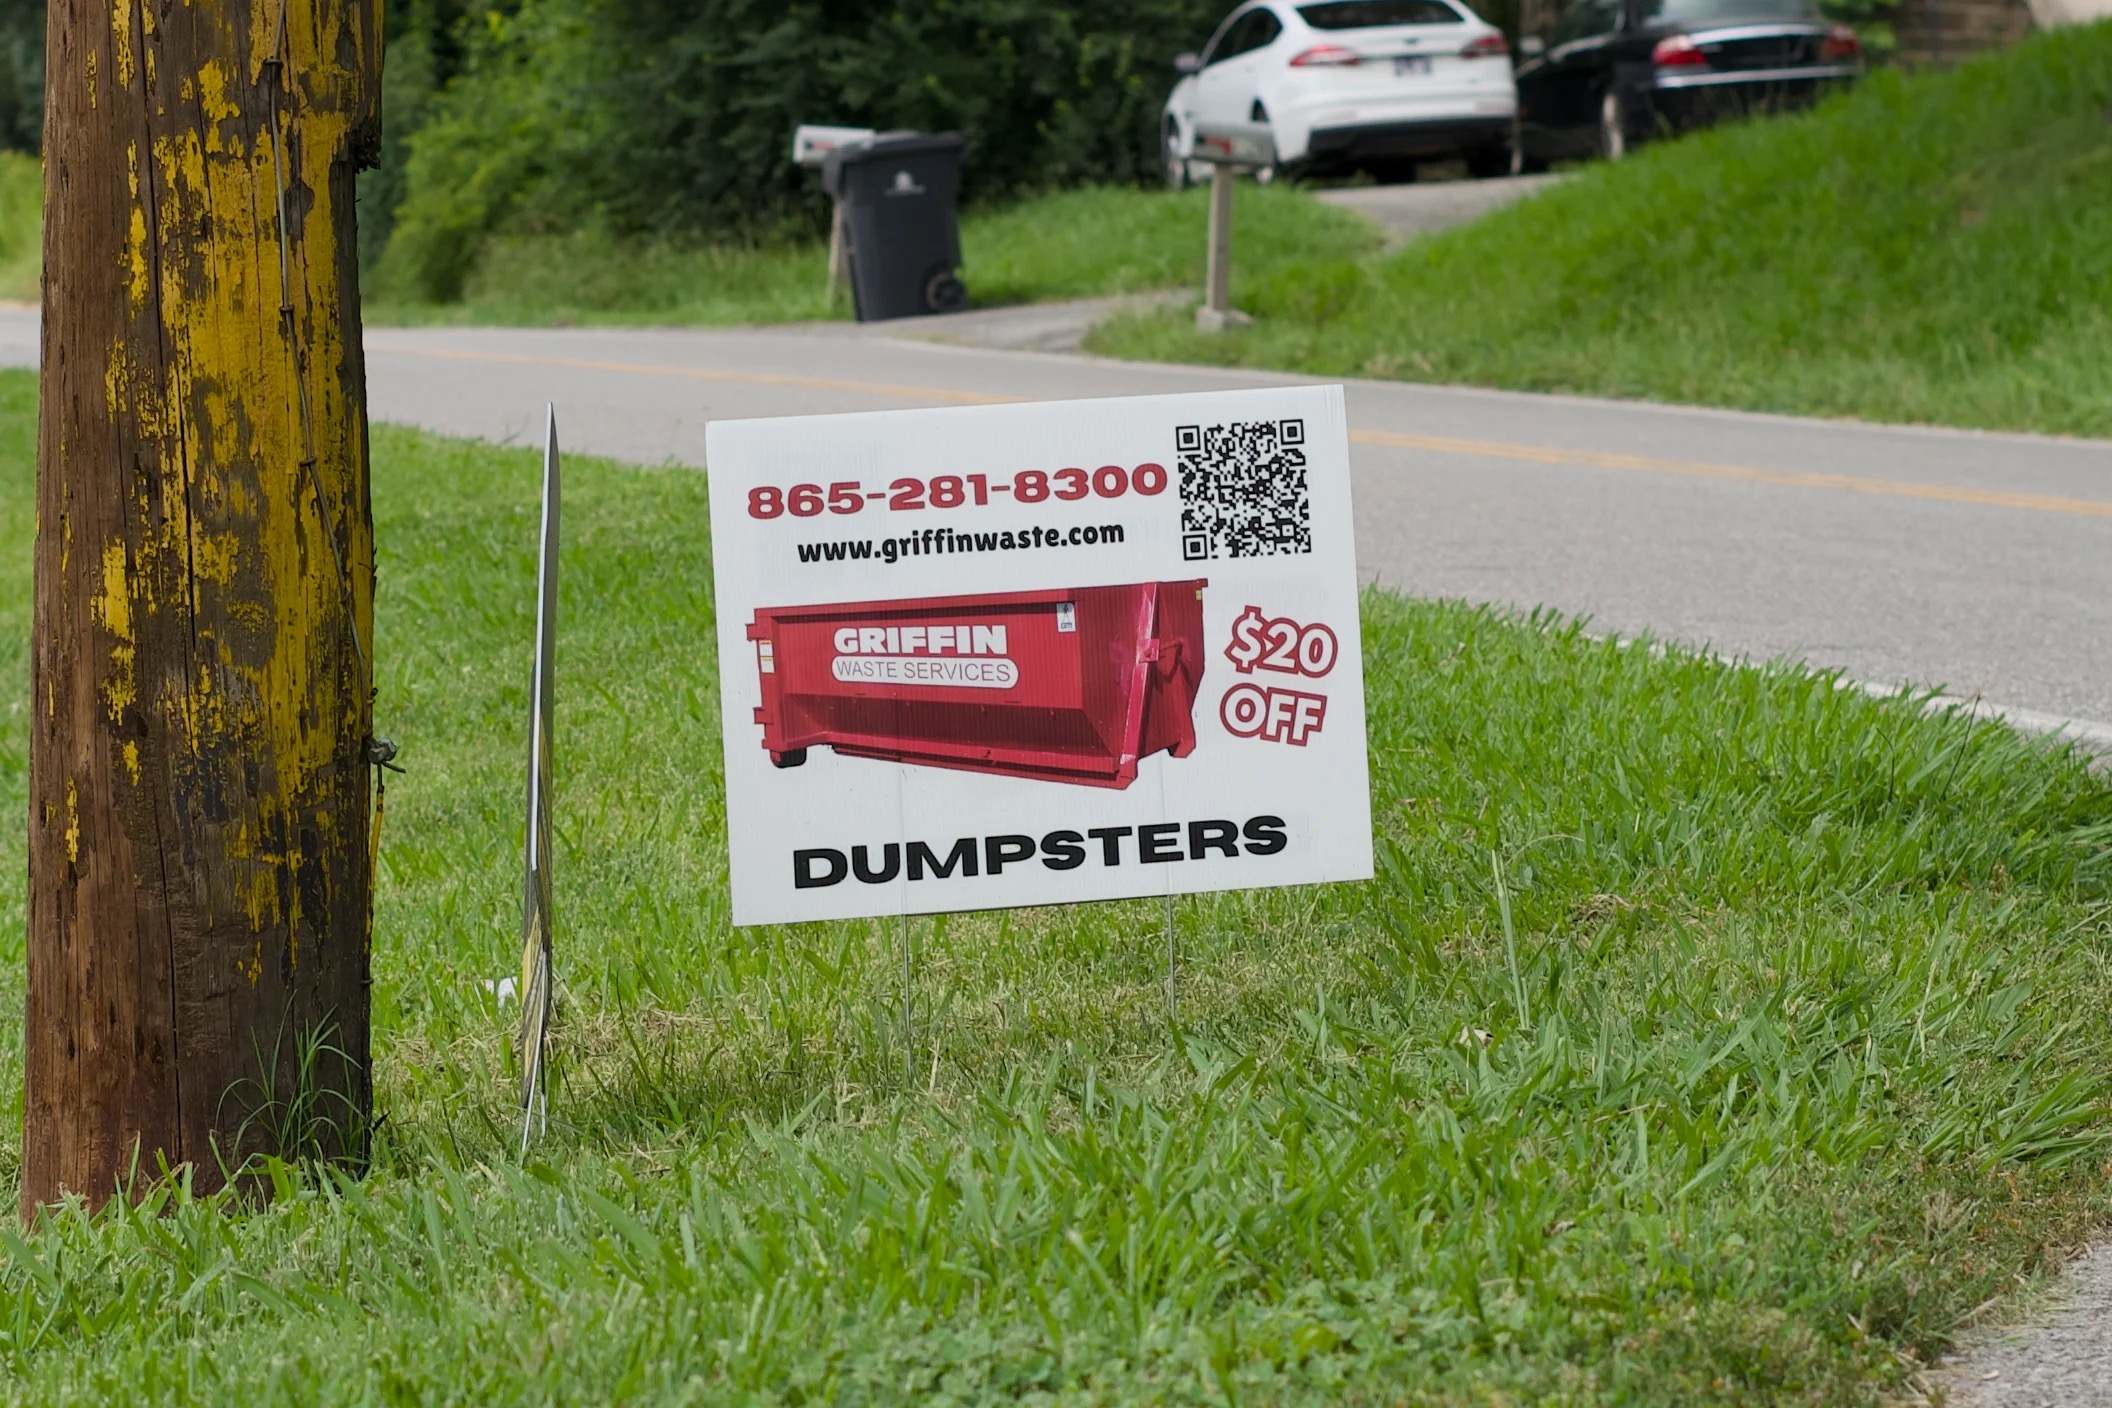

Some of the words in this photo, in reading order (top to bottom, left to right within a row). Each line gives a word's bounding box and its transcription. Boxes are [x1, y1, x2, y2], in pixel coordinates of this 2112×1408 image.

[749, 463, 1168, 519] 865-281-8300
[798, 522, 1125, 564] www.griffinwaste.com
[834, 625, 1008, 655] GRIFFIN
[1224, 605, 1339, 679] $20
[836, 660, 898, 678] WASTE
[904, 662, 1011, 682] SERVICES
[1219, 682, 1328, 747] OFF
[794, 816, 1288, 889] DUMPSTERS
